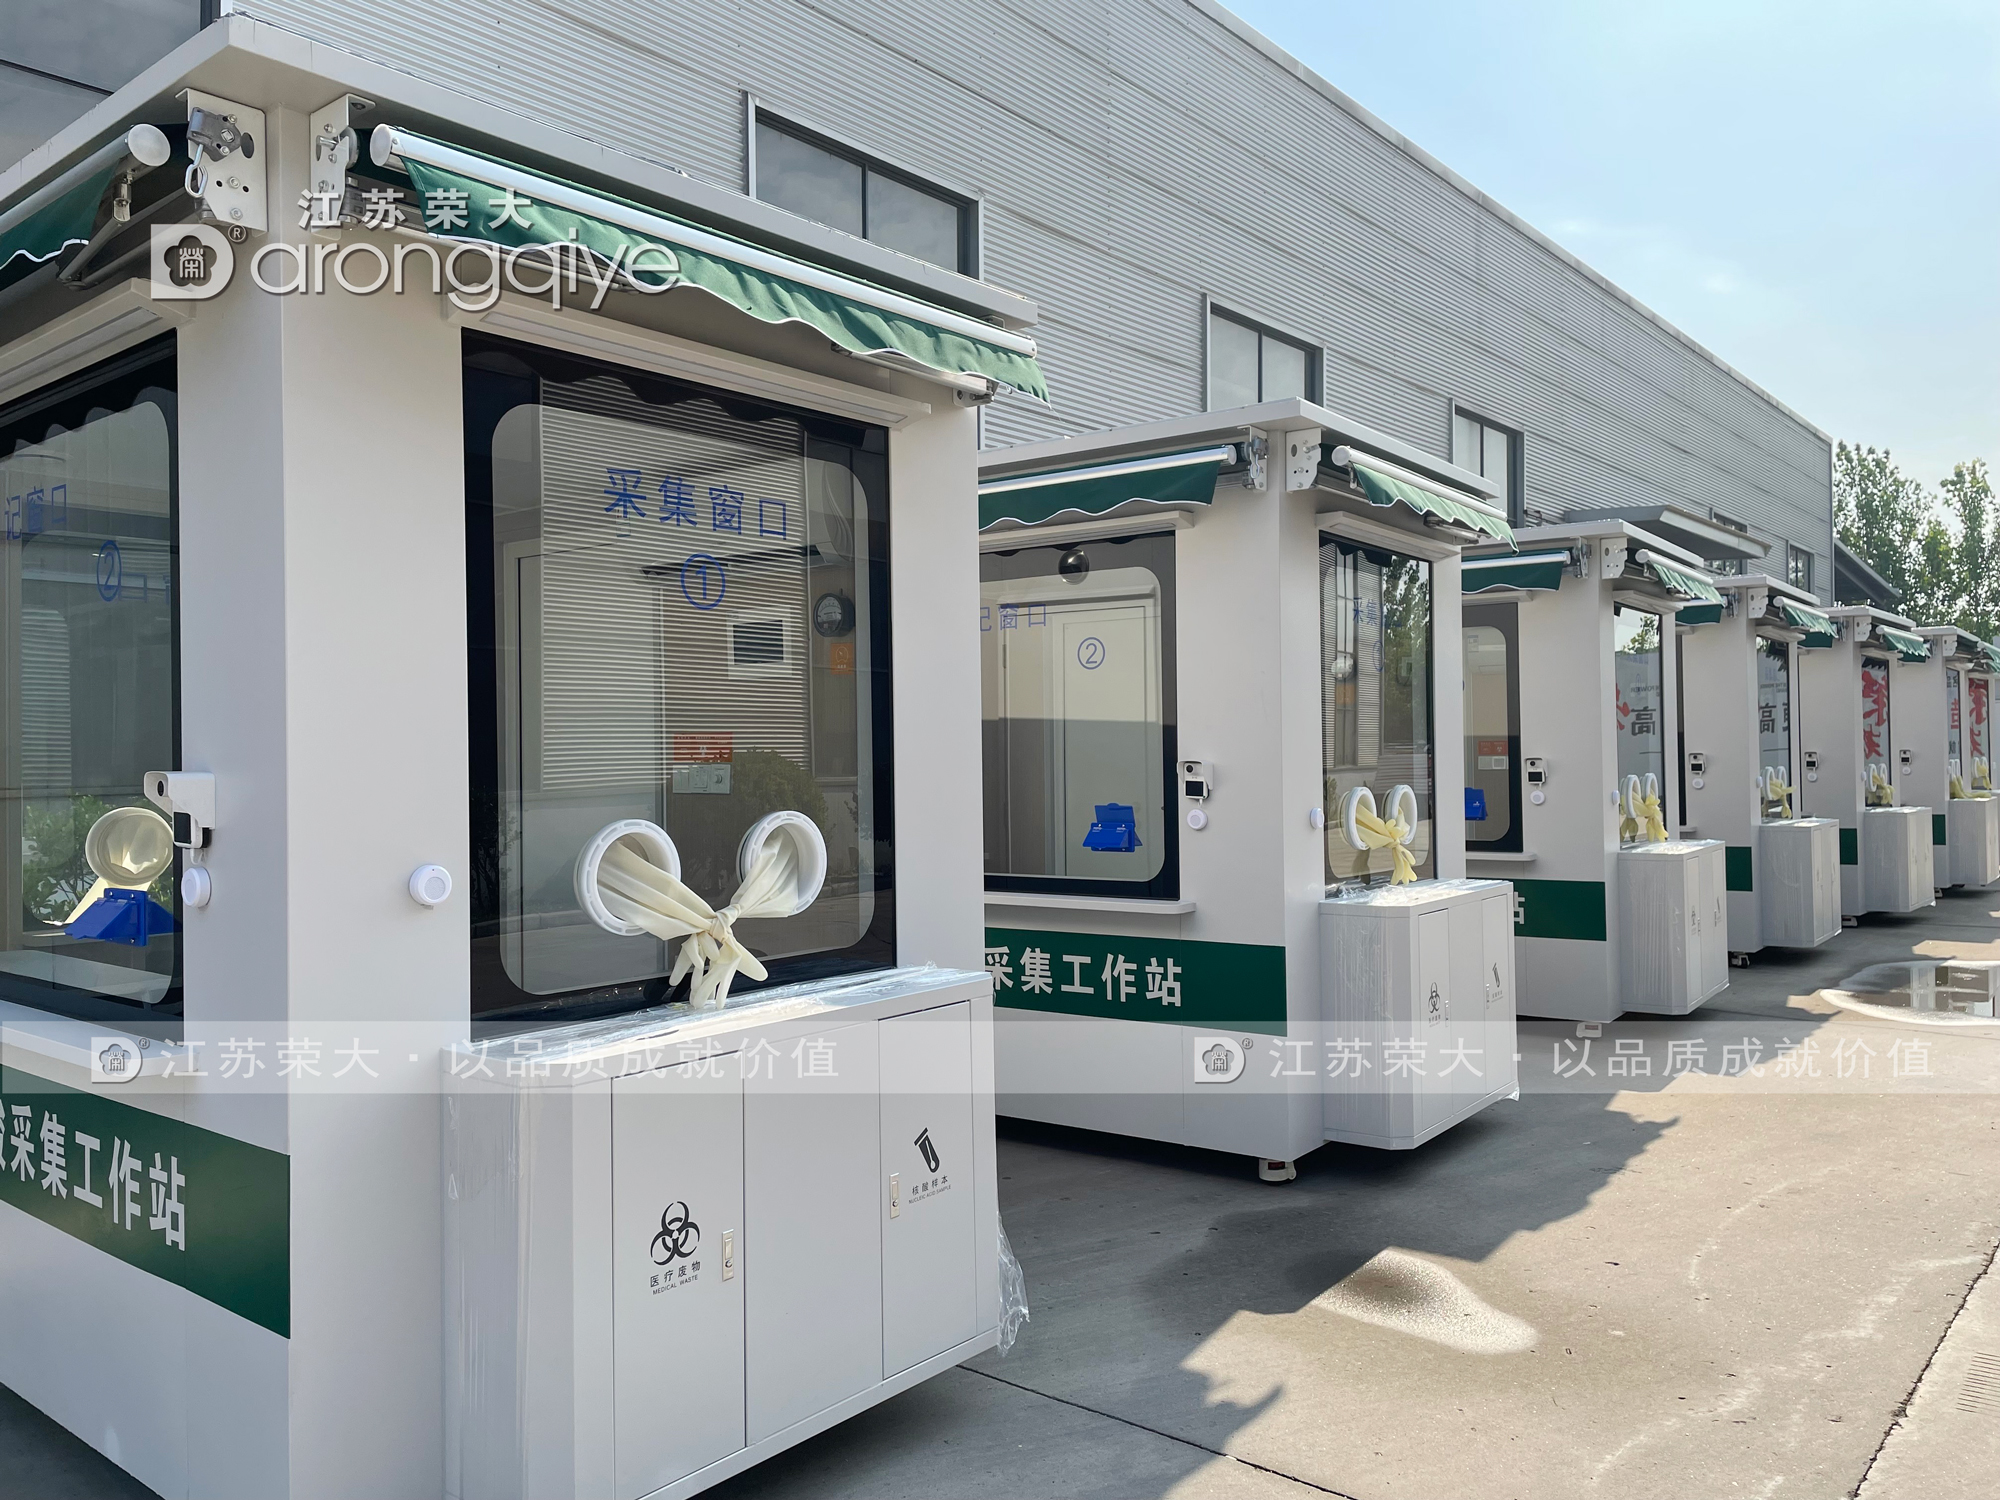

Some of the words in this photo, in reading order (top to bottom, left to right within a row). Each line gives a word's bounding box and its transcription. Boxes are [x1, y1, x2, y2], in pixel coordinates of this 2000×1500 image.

[603, 468, 787, 540] 采集窗口
[985, 946, 1182, 1007] 采集工作站
[0, 1100, 185, 1251] 采集工作站
[650, 1260, 700, 1288] 医疗废物
[652, 1282, 677, 1295] MEDICAL
[680, 1274, 698, 1286] WASTE
